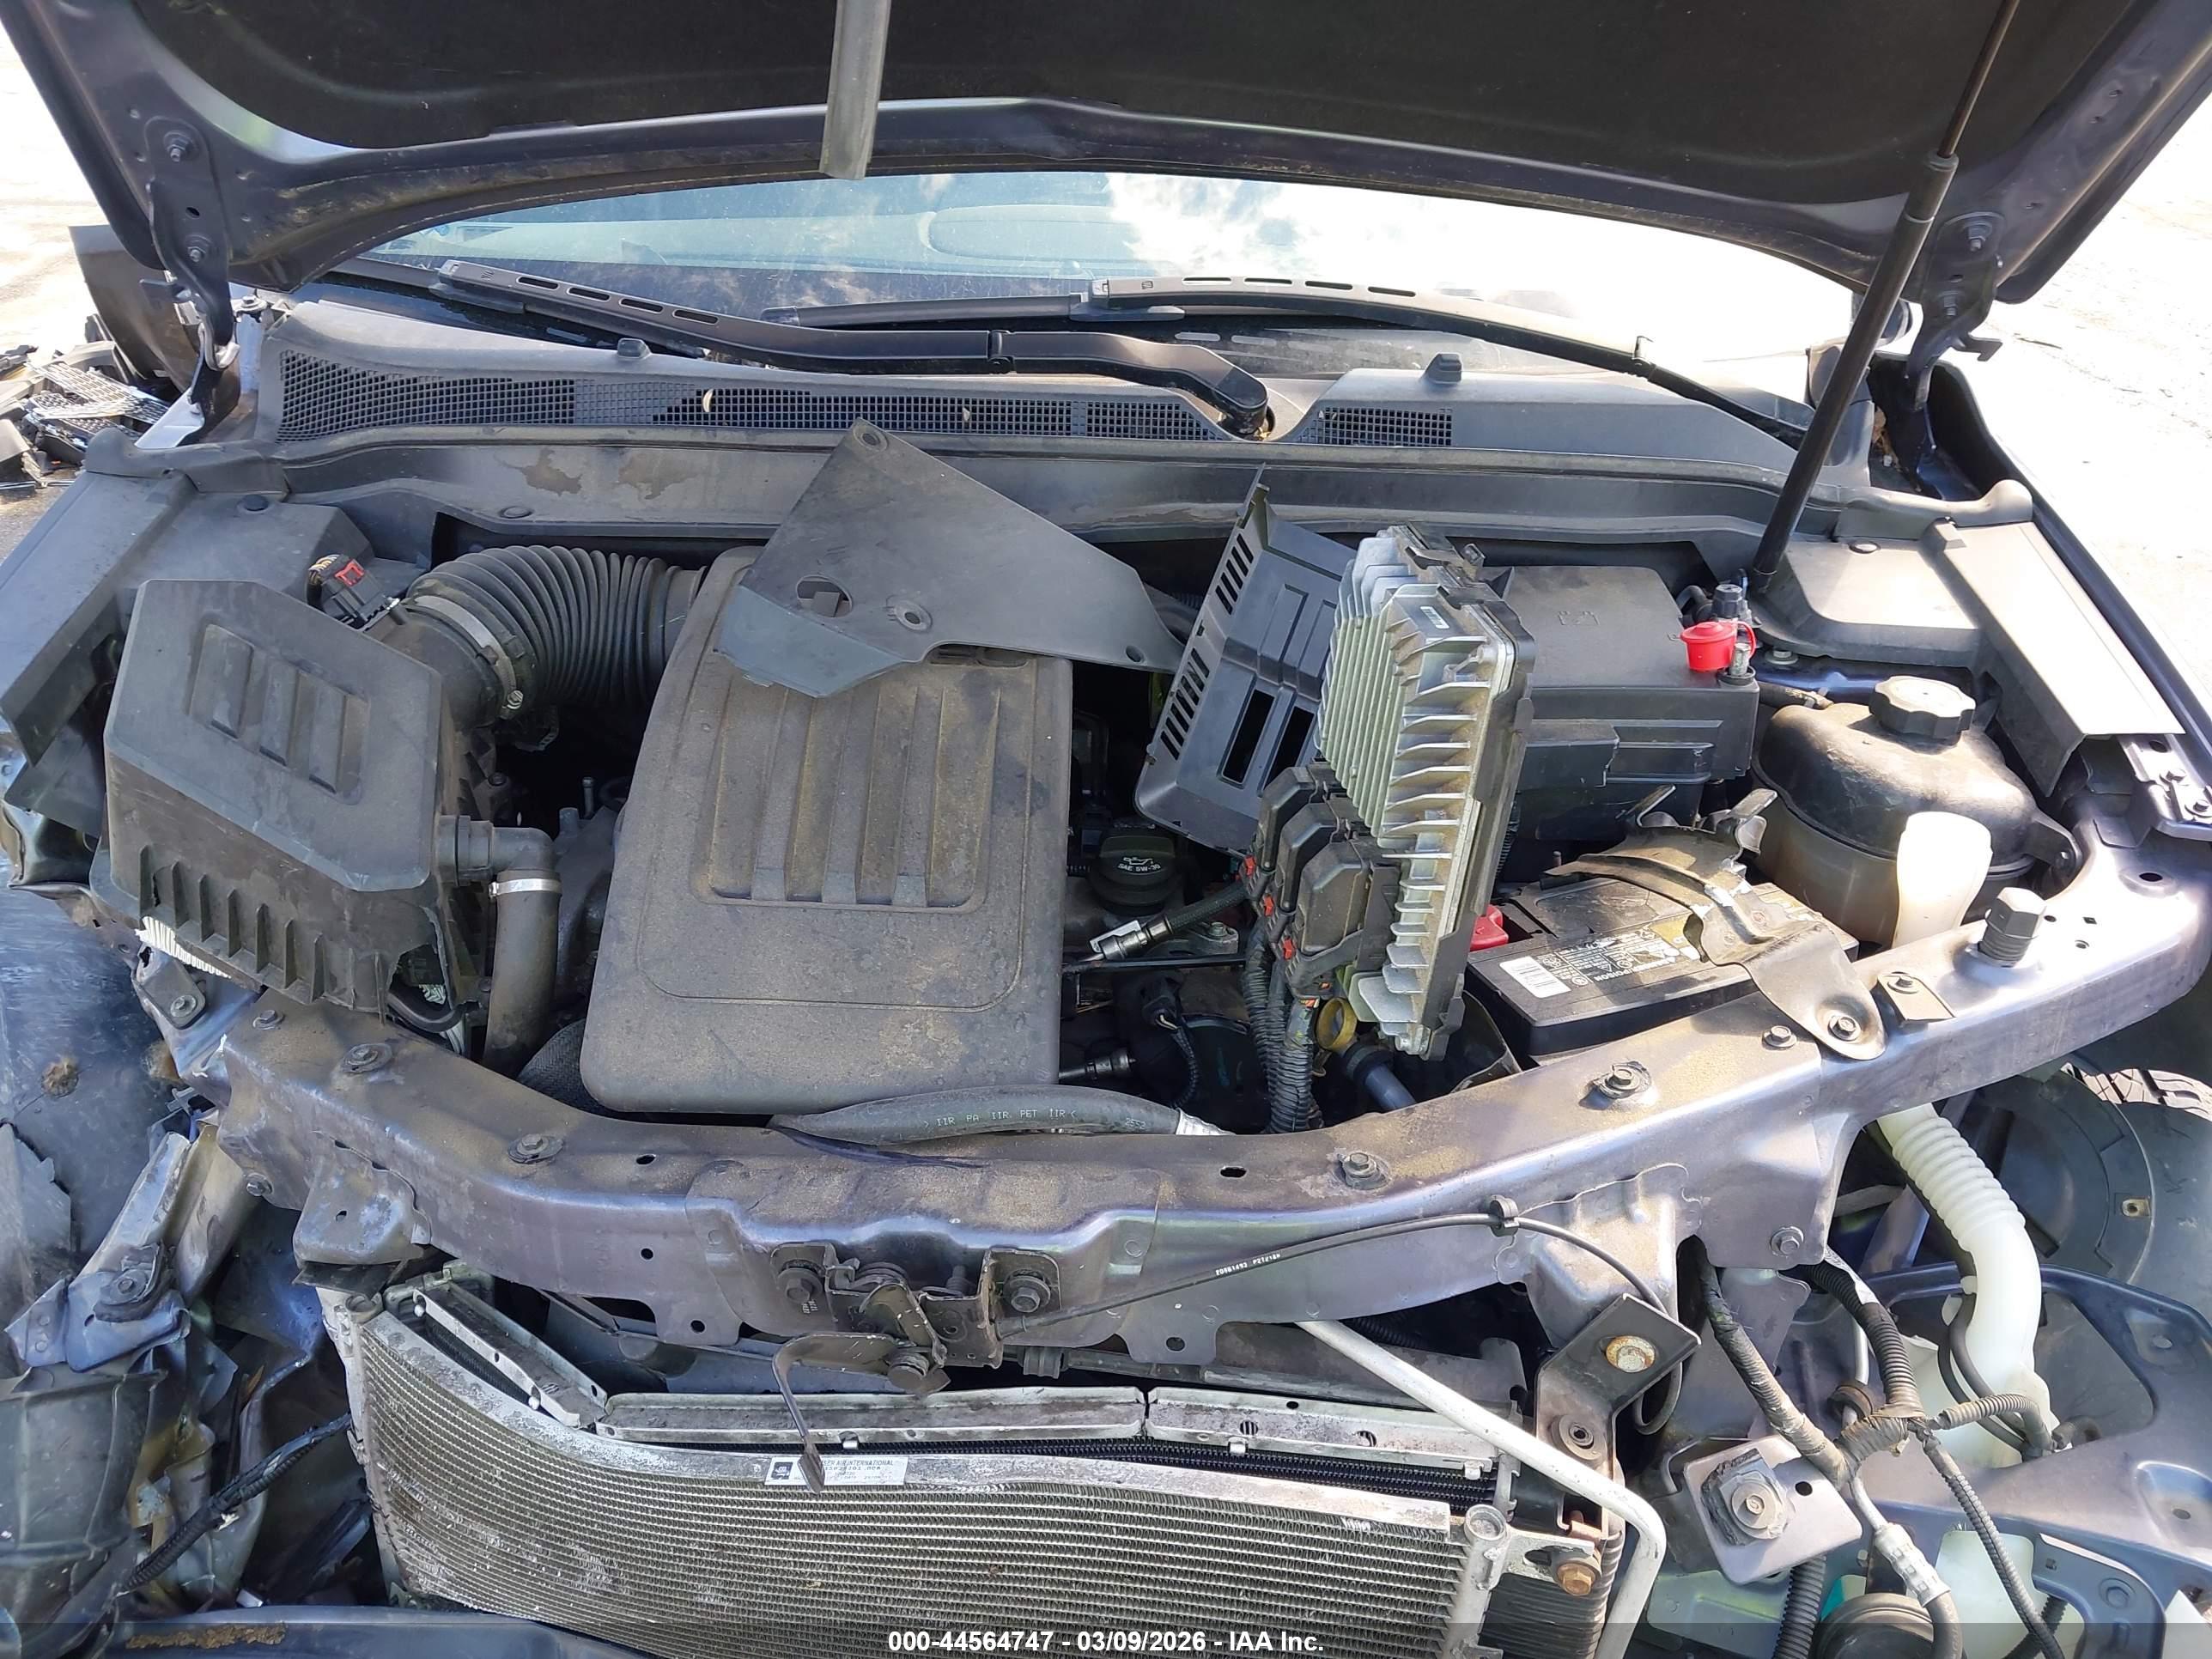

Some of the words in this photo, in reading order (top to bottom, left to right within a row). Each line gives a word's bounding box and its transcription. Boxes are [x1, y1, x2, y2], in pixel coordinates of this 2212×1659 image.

[1118, 863, 1133, 872] SAE
[966, 1114, 980, 1123] PA
[992, 1111, 1010, 1120] IIR
[1019, 1109, 1038, 1118] PET
